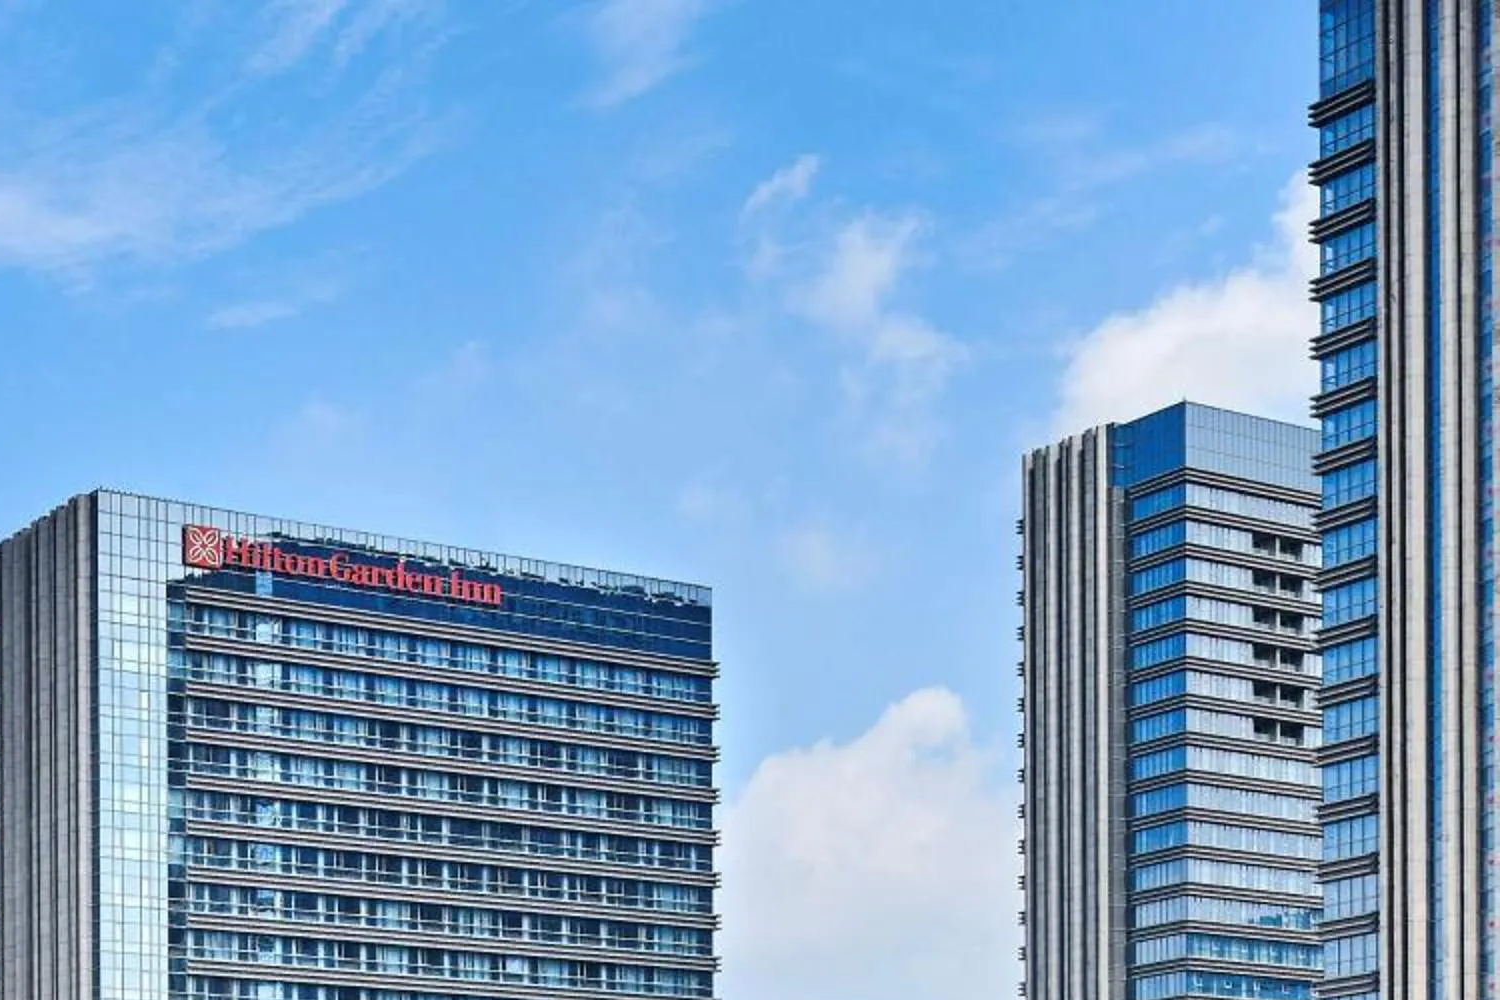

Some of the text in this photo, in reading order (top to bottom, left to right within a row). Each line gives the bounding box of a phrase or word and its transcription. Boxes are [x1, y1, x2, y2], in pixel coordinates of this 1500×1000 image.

[224, 535, 502, 605] Hilton Garden Inn
